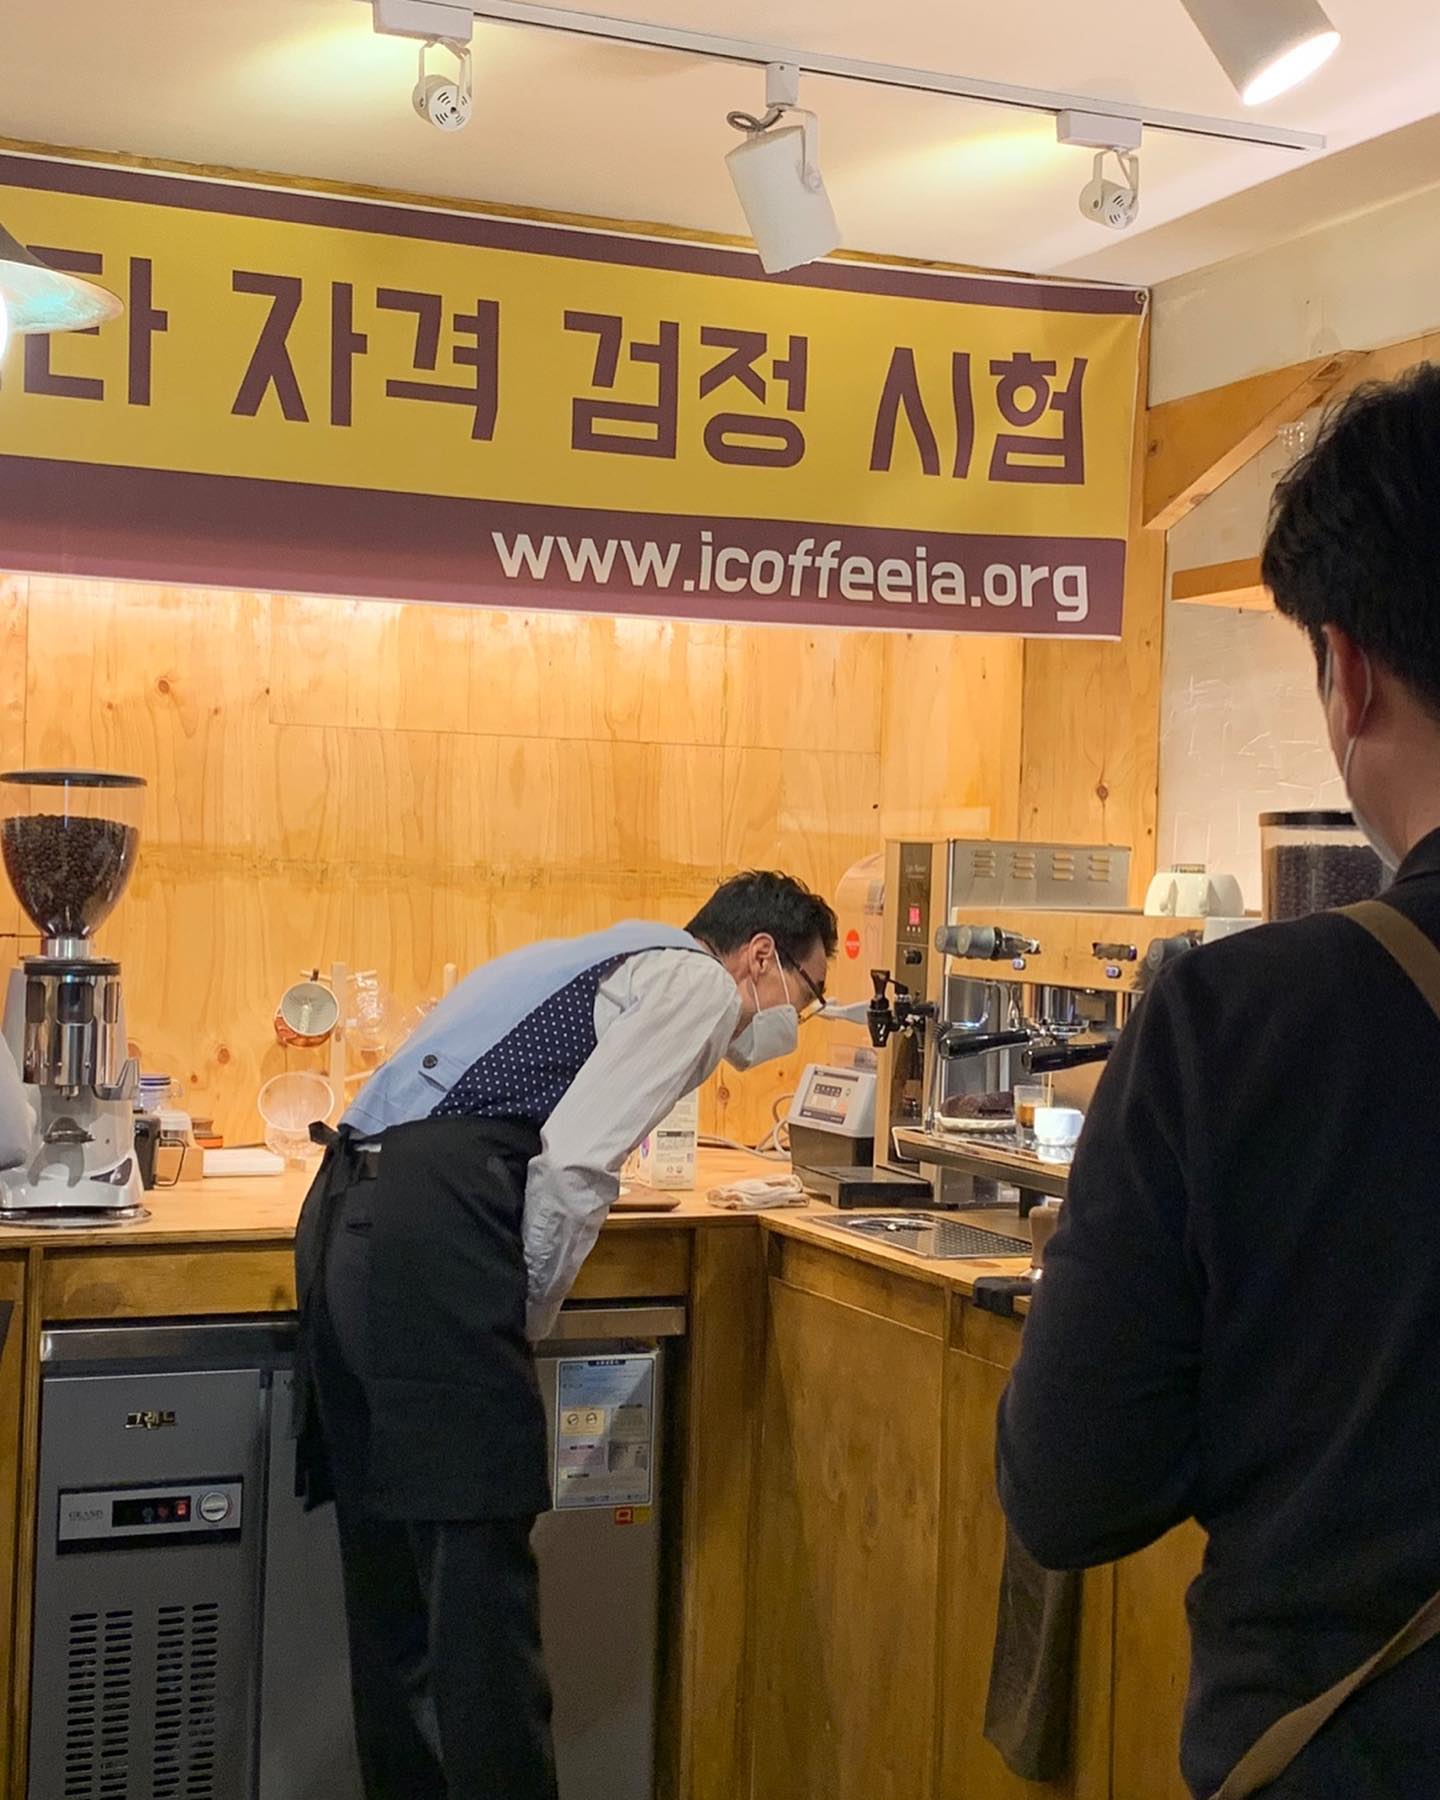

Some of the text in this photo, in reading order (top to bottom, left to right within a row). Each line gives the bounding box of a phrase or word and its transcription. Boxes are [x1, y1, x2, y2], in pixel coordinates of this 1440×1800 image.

[231, 270, 499, 442] 자격
[564, 310, 808, 468] 검정
[869, 346, 1088, 486] 시험
[490, 530, 1089, 624] www.icoffeeia.org
